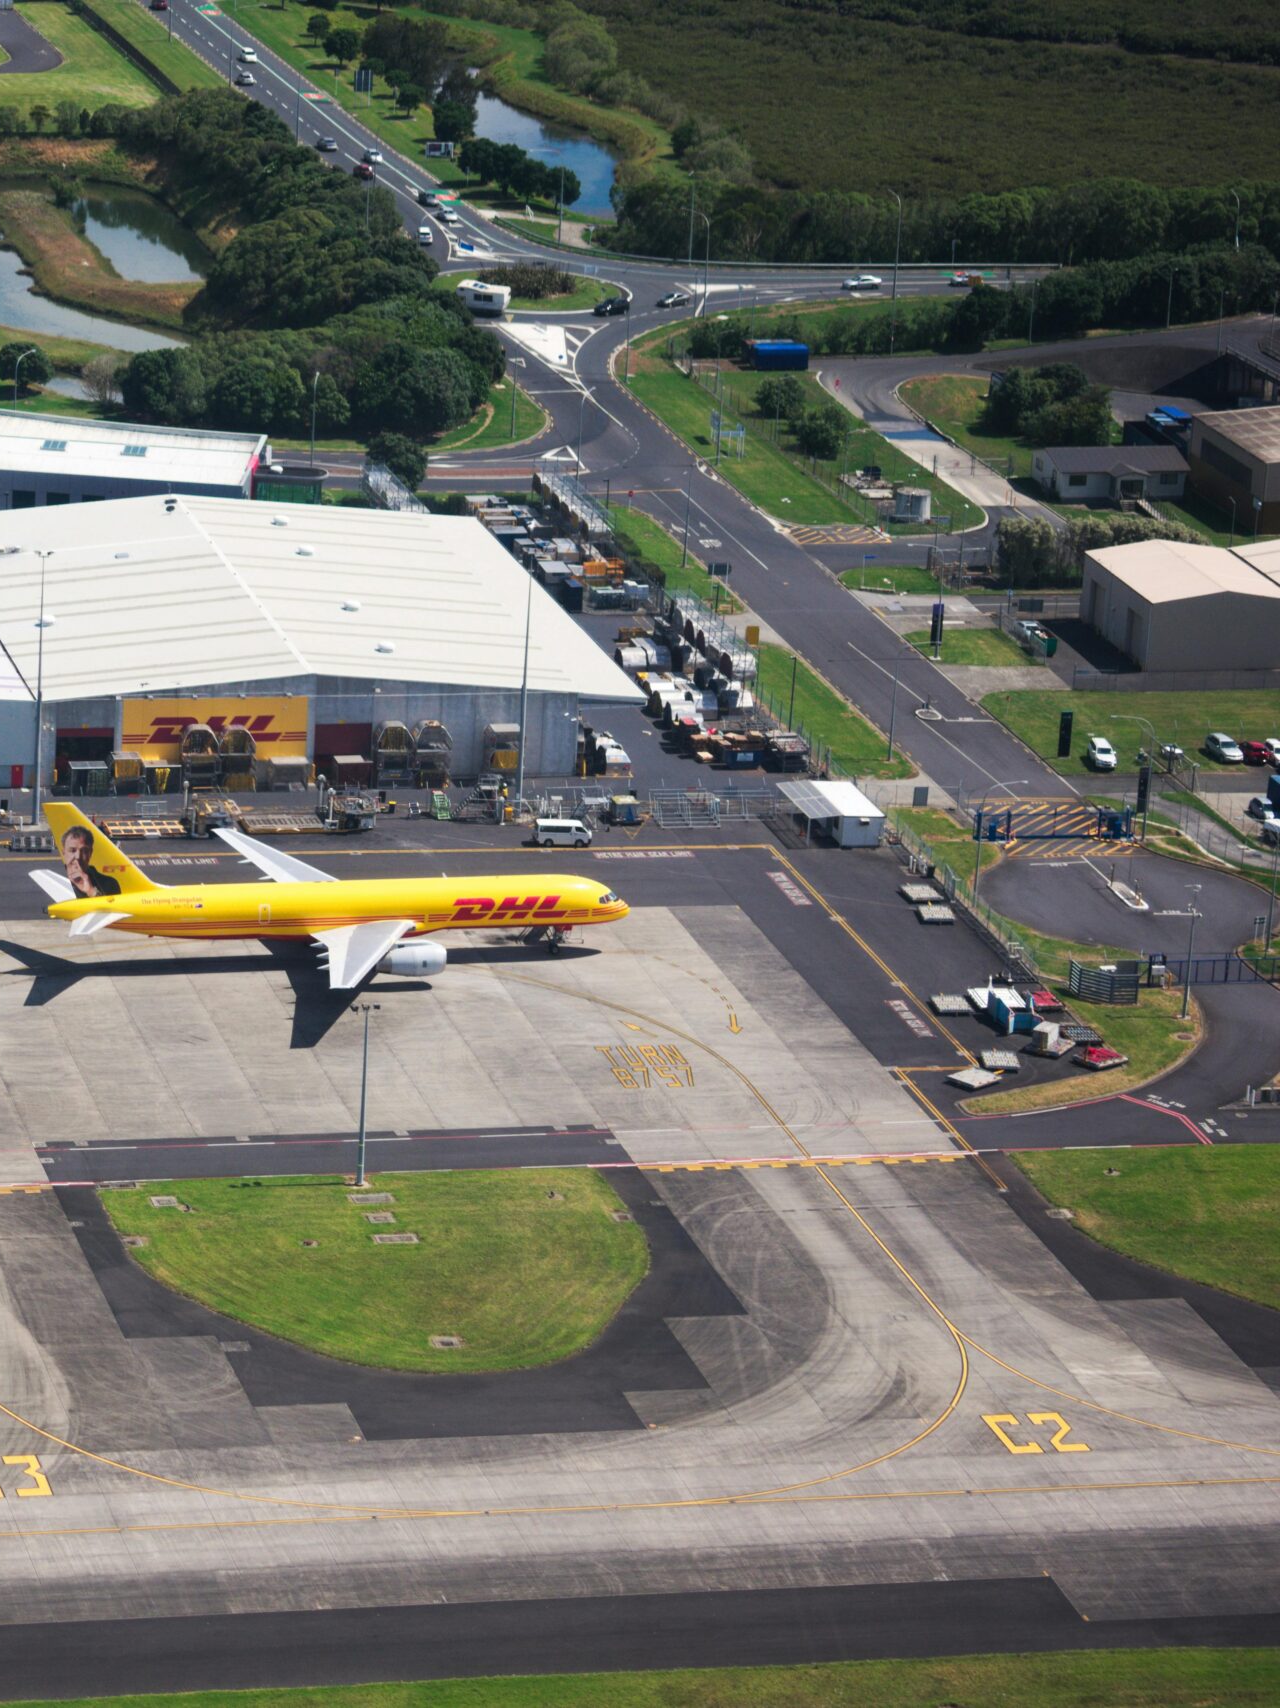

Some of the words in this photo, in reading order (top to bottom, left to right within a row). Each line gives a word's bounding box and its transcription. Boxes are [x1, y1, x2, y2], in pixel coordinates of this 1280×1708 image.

[450, 895, 568, 922] DHL
[594, 1044, 688, 1068] TURN
[611, 1066, 695, 1089] B757
[980, 1411, 1092, 1455] C2
